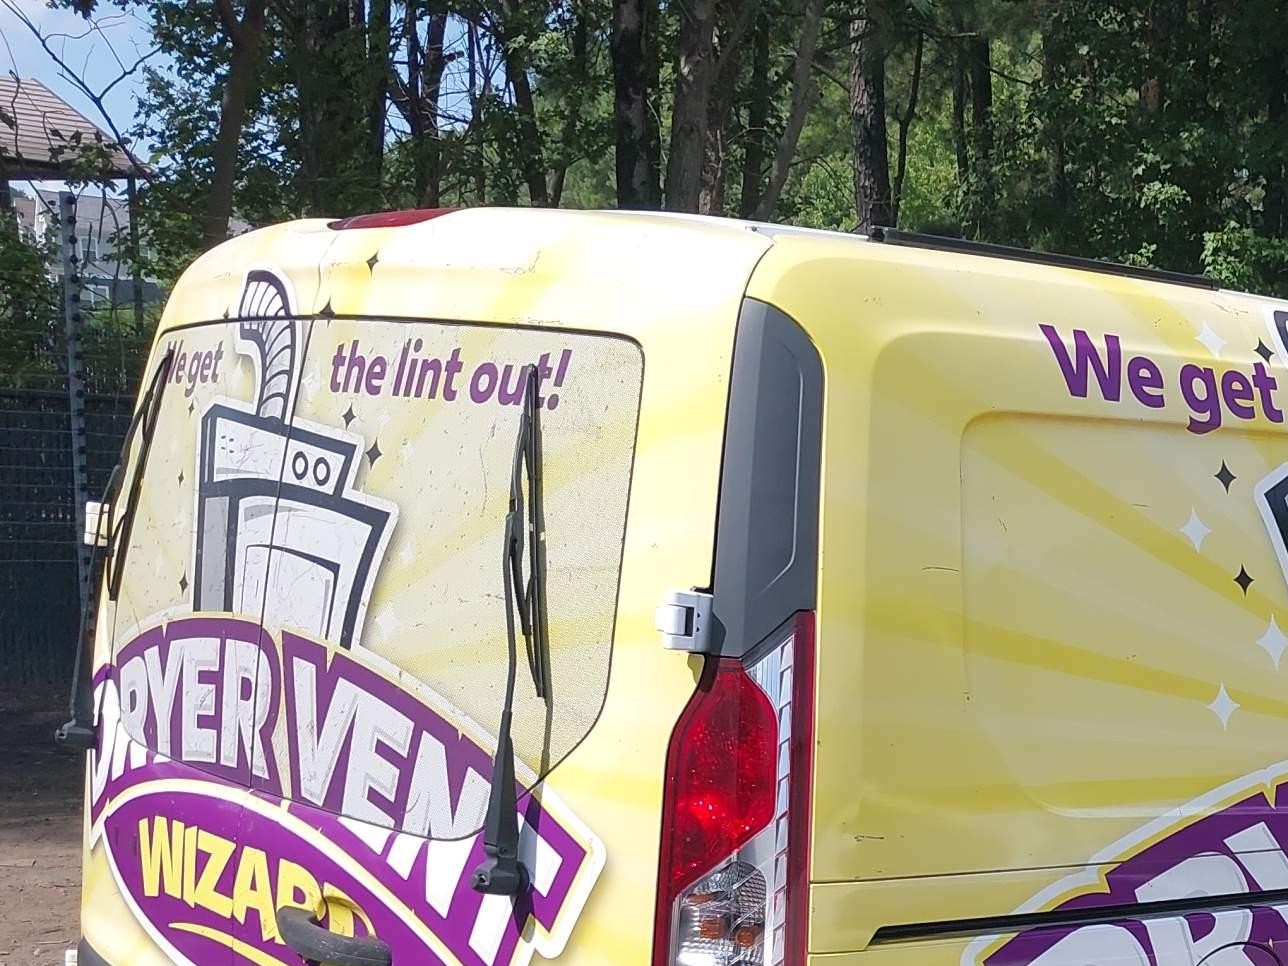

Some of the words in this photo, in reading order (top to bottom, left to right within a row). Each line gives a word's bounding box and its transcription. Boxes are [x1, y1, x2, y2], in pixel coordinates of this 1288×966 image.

[184, 339, 224, 398] get
[330, 341, 387, 397] the
[392, 338, 463, 403] lint
[469, 348, 573, 411] out!
[1037, 322, 1167, 410] We
[1178, 360, 1285, 435] get
[91, 637, 271, 808] DRYER
